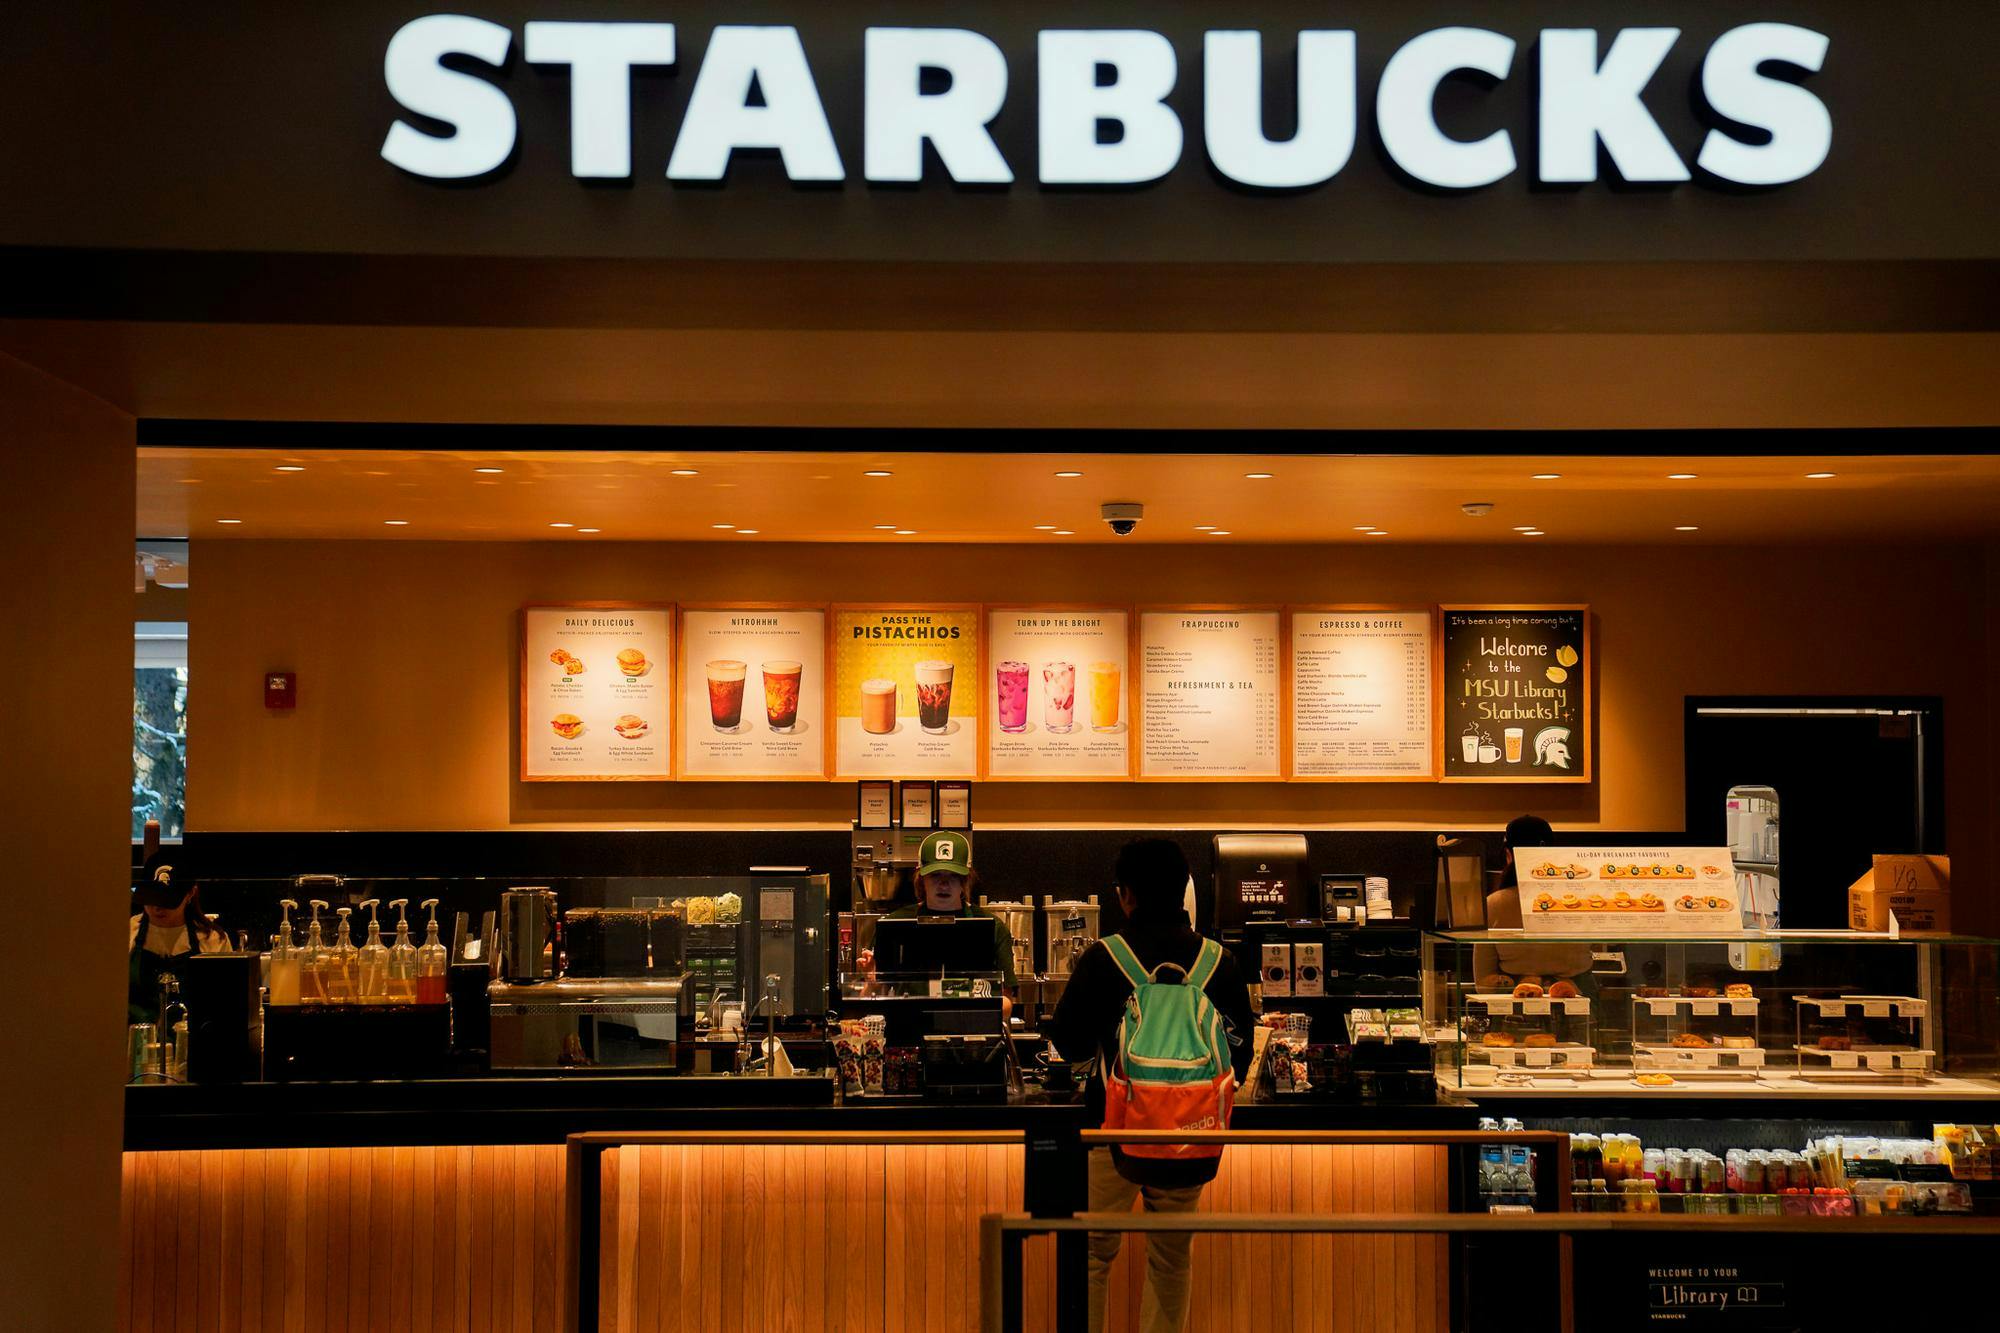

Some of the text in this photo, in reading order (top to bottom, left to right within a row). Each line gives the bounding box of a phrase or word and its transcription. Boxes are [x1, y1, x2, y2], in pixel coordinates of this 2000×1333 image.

[381, 13, 1834, 188] STARBUCKS
[565, 618, 635, 627] DAILY DELICIOUS
[732, 618, 778, 626] NITROHHHH
[882, 616, 931, 624] PASS THE
[1017, 619, 1101, 627] TURN UP THE BRIGHT
[1451, 616, 1466, 625] It's
[1469, 616, 1487, 625] been
[1495, 616, 1511, 629] long
[1512, 616, 1528, 625] time
[1530, 617, 1558, 629] coming
[853, 626, 961, 639] PISTACHIOS
[1481, 637, 1548, 656] Welcome
[1488, 660, 1521, 673] to the
[1168, 681, 1253, 689] REFRESHMENT & TEA
[1465, 679, 1567, 707] MSU Library
[1478, 700, 1559, 720] Starbucks!
[1649, 1268, 1738, 1278] WELCOME TO YOUR
[1662, 1285, 1729, 1310] Library
